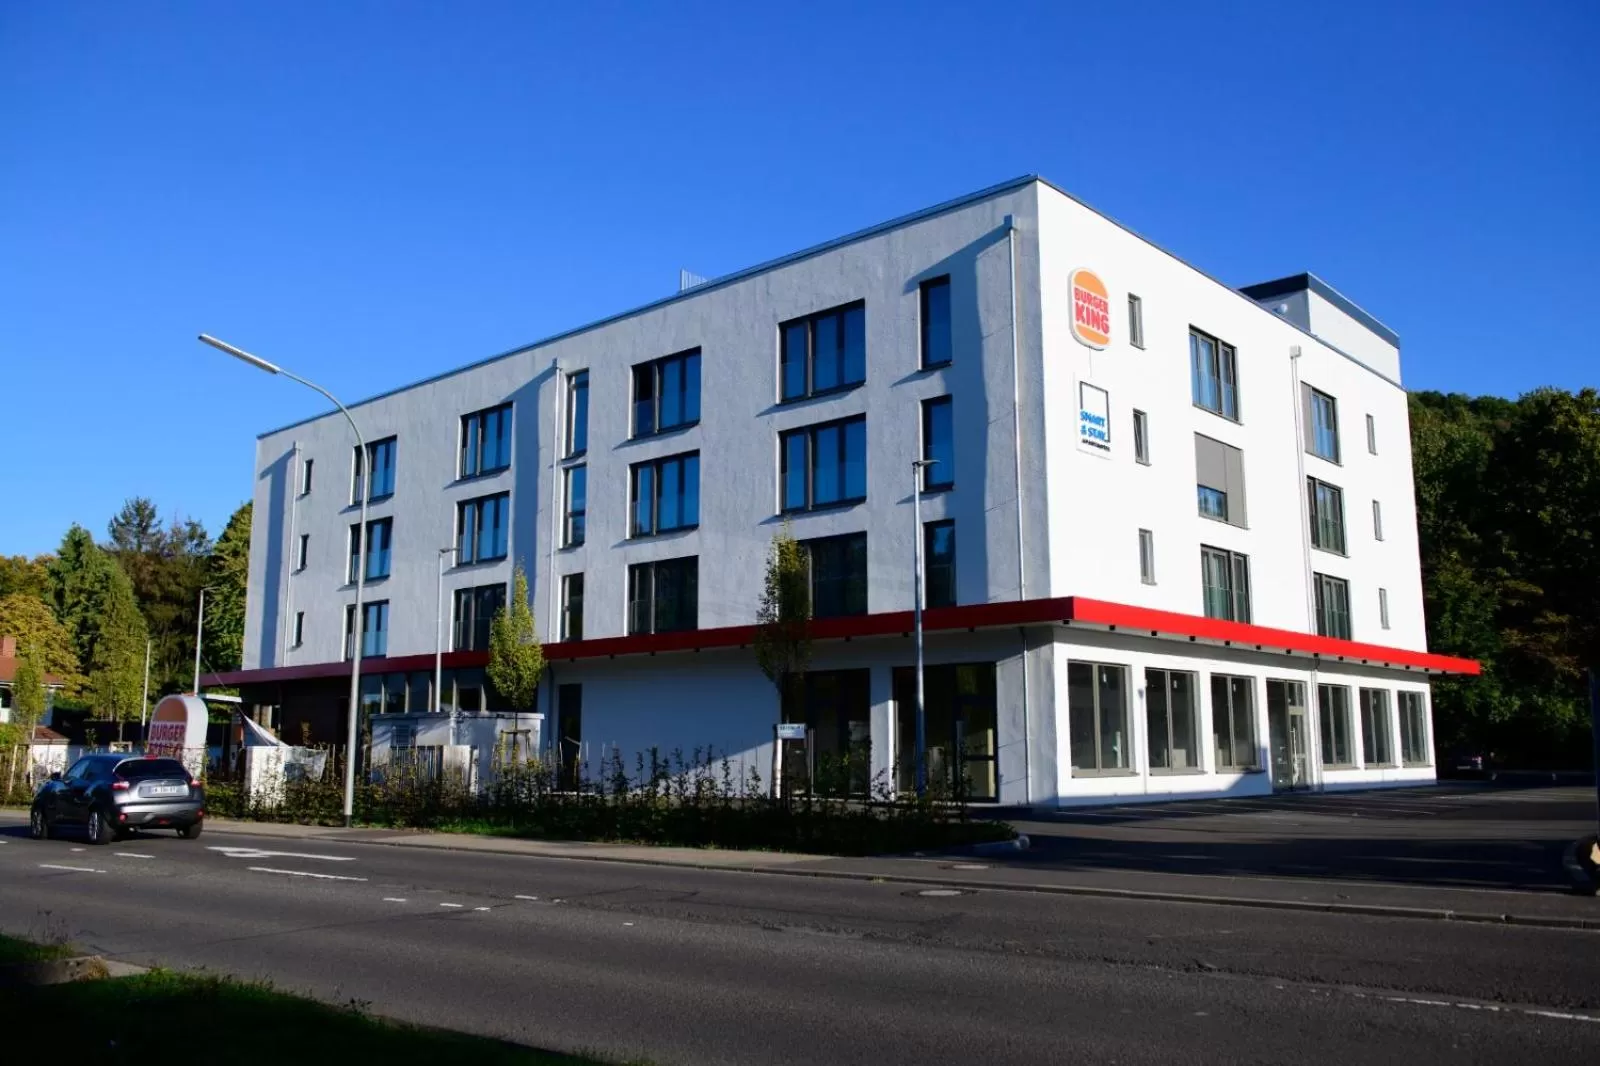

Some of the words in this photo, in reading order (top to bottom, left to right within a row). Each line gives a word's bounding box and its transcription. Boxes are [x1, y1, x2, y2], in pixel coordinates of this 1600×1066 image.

[1074, 287, 1109, 314] BURGER
[1075, 301, 1110, 334] KING
[150, 723, 186, 741] BURGER
